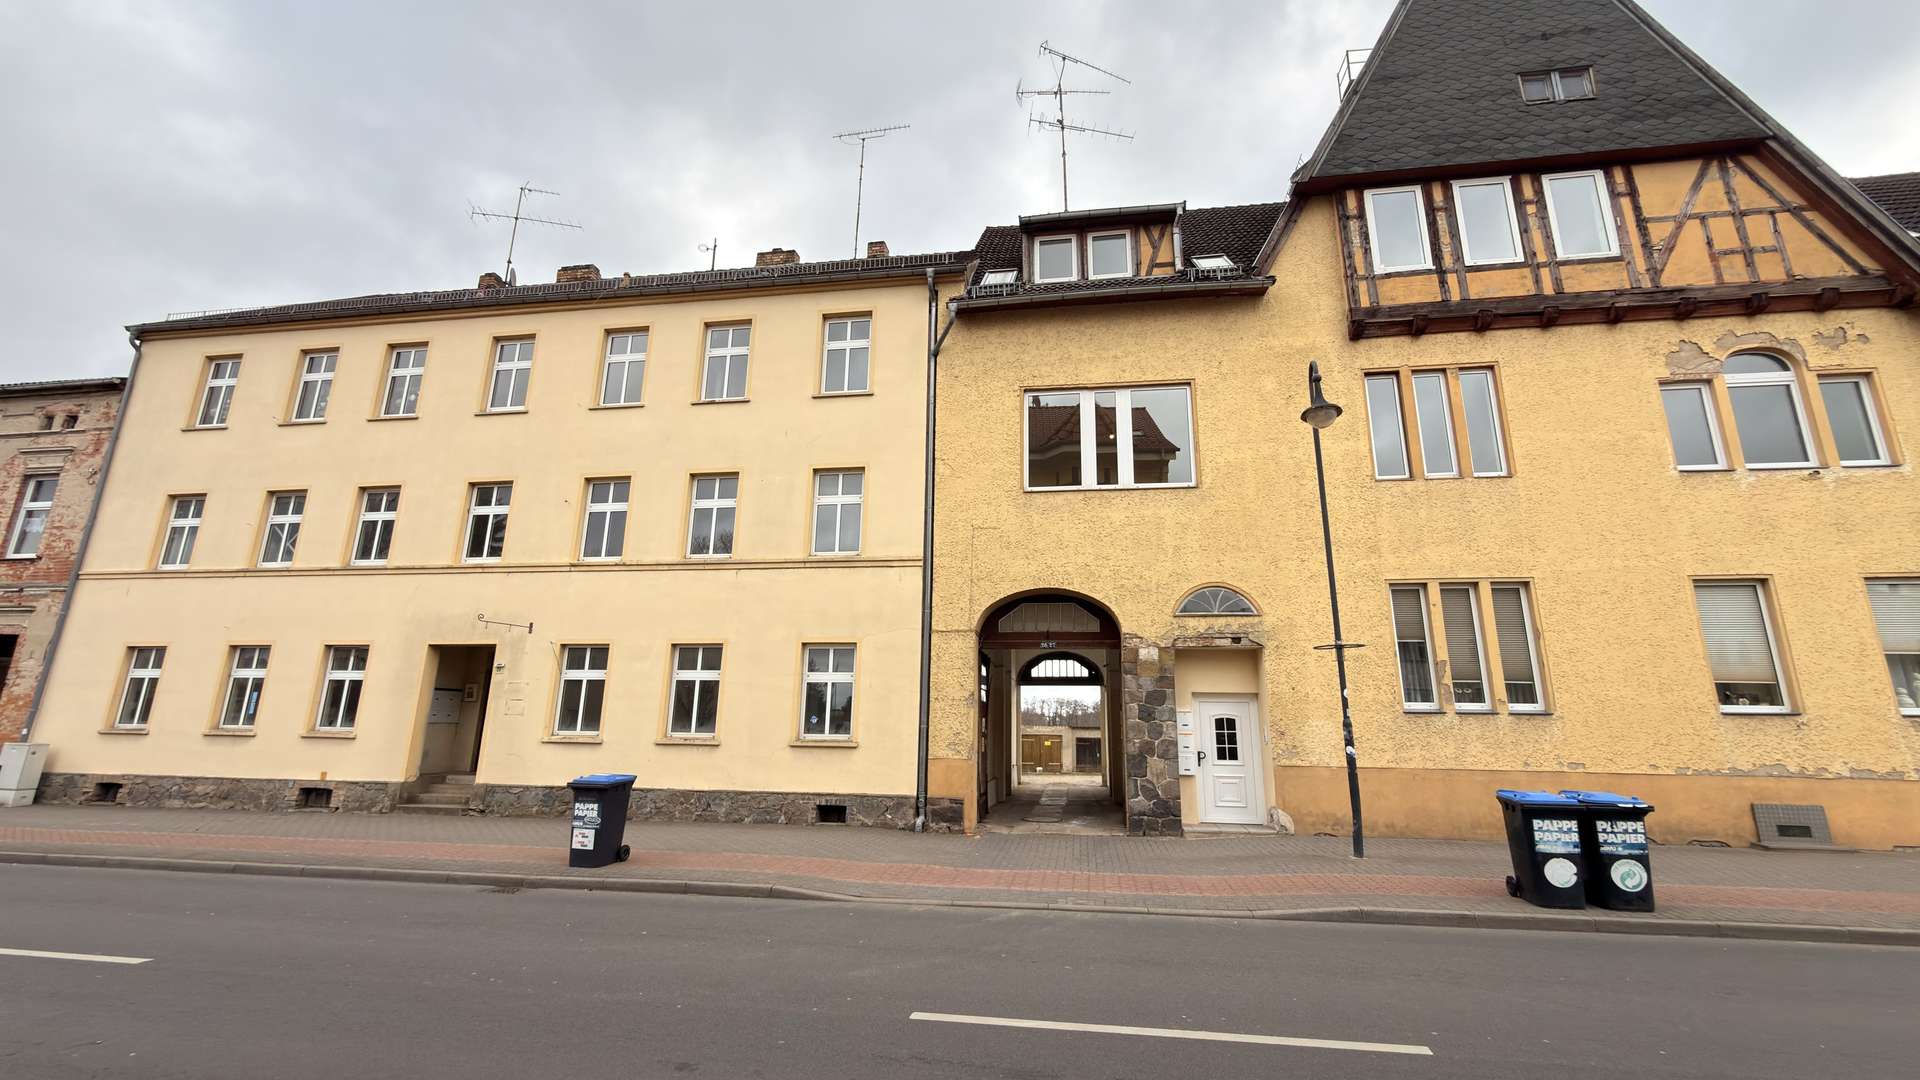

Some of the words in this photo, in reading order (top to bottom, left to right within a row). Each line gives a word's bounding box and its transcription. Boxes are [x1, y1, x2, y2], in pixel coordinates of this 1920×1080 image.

[574, 802, 598, 810] PAPPE
[1532, 819, 1579, 831] PAPPE
[1534, 831, 1580, 842] PAPIER
[1598, 832, 1647, 843] PAPIER
